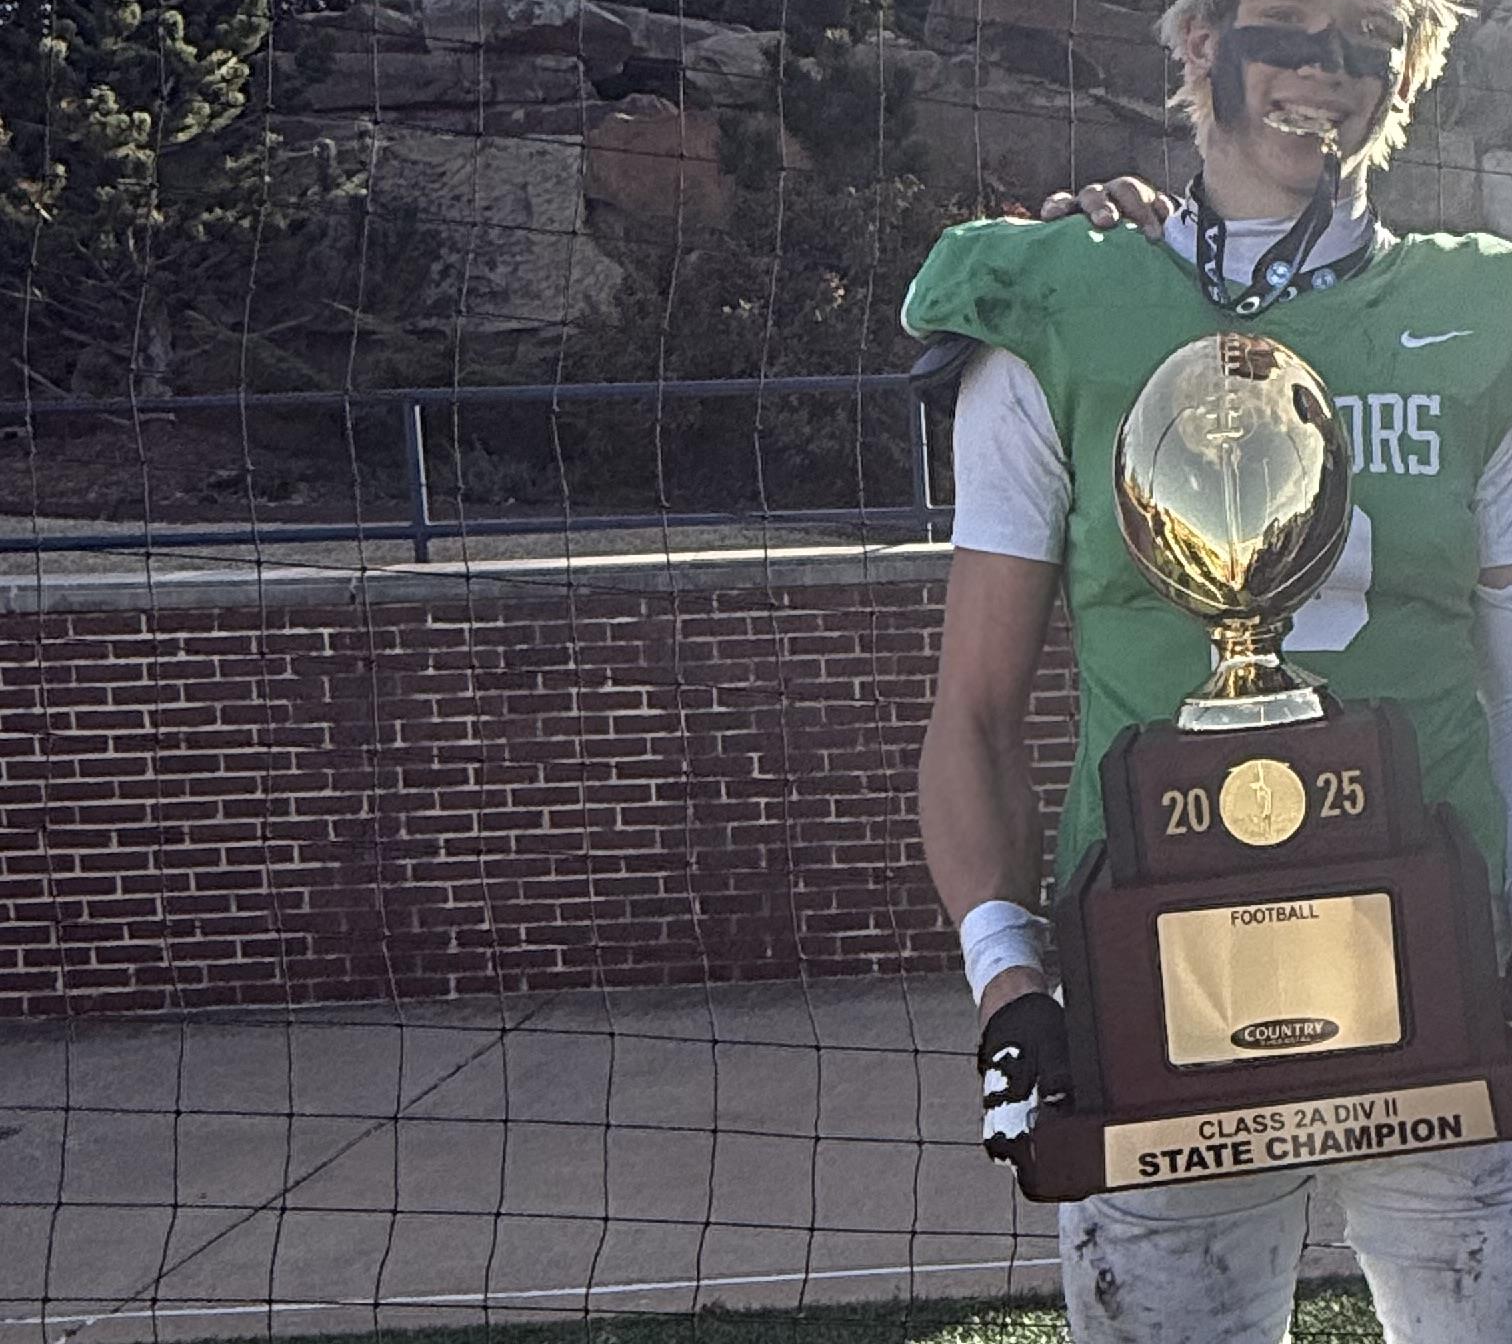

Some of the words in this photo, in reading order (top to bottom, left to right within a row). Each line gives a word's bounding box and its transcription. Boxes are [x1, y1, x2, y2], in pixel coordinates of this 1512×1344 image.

[1161, 788, 1211, 837] 20
[1316, 769, 1366, 819] 25
[1230, 903, 1320, 927] FOOTBALL
[1244, 1020, 1325, 1042] COUNTRY
[1198, 1111, 1286, 1140] CLASS
[1294, 1107, 1328, 1130] 2A
[1334, 1100, 1376, 1125] DIV
[1384, 1097, 1398, 1118] II
[1138, 1140, 1254, 1178] STATE
[1265, 1113, 1463, 1163] CHAMPION
